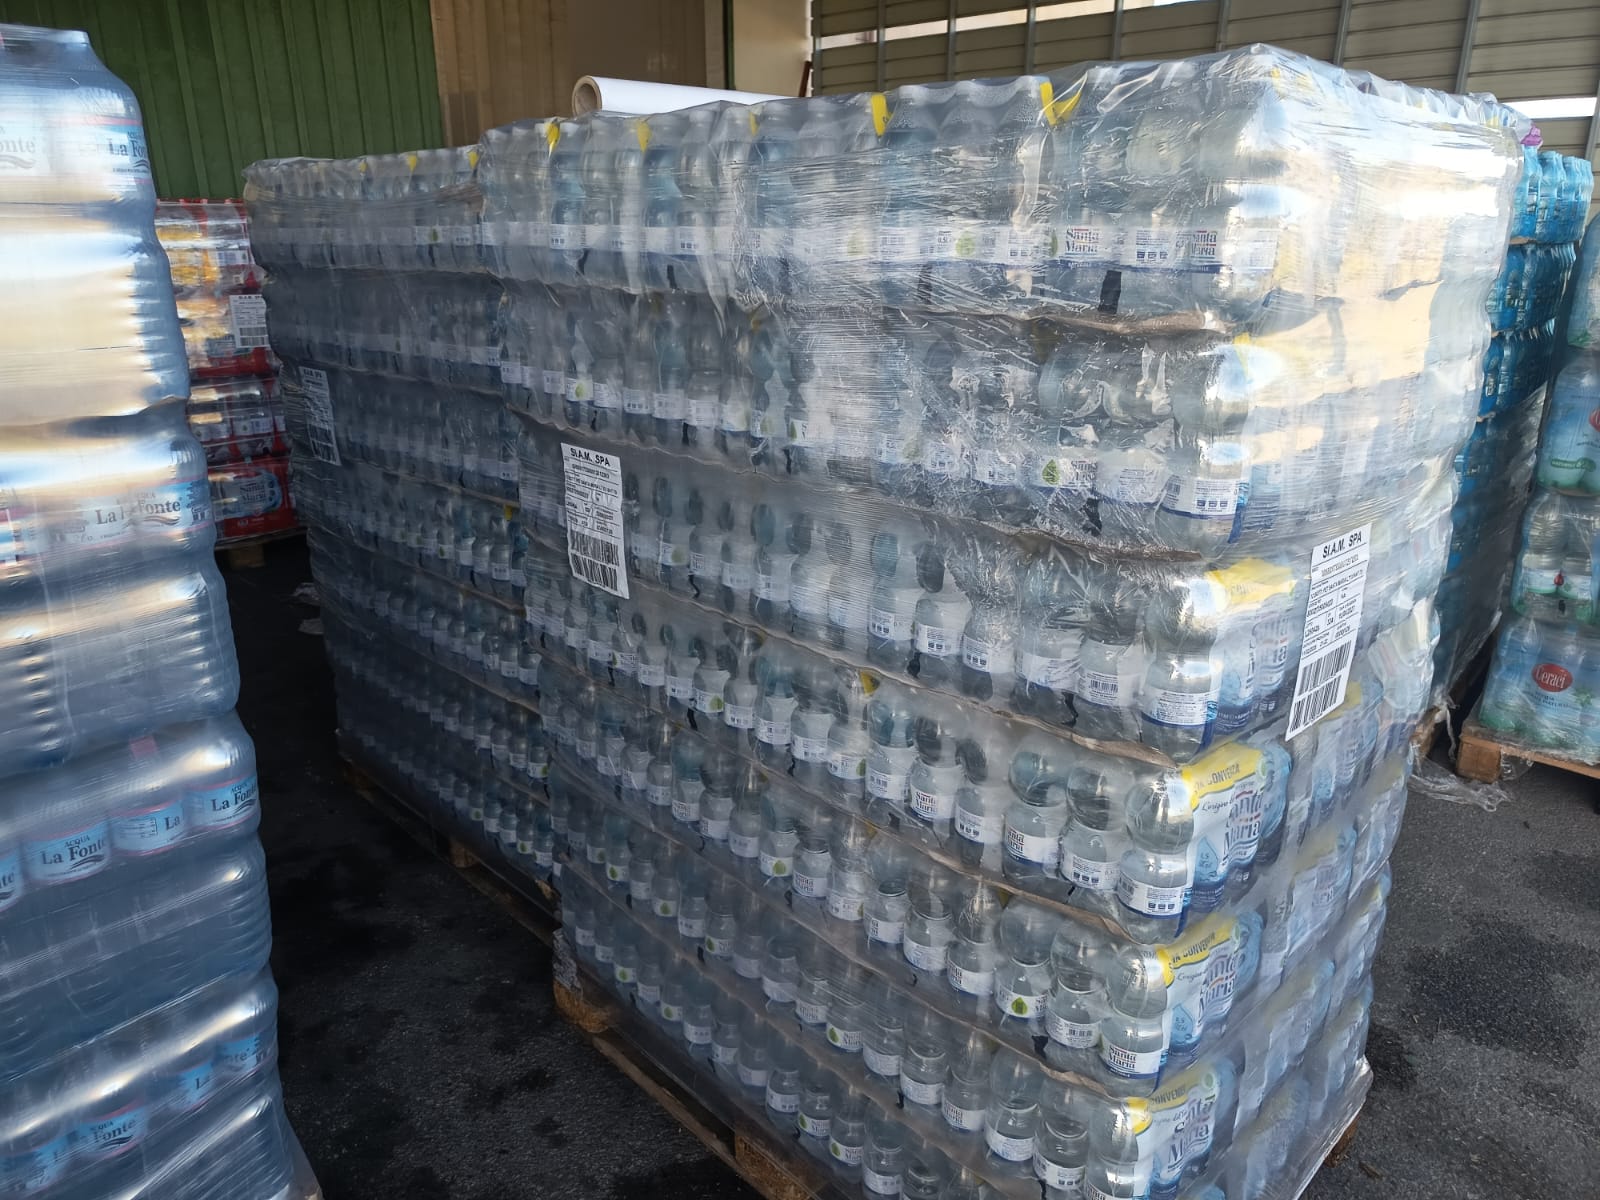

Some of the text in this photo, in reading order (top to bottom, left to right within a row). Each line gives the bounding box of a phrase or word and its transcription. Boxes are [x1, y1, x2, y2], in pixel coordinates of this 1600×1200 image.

[594, 454, 610, 466] SPA
[96, 499, 182, 525] La Fonte
[1348, 531, 1362, 547] SPA
[210, 798, 229, 812] La
[165, 815, 180, 831] La
[41, 850, 63, 865] La
